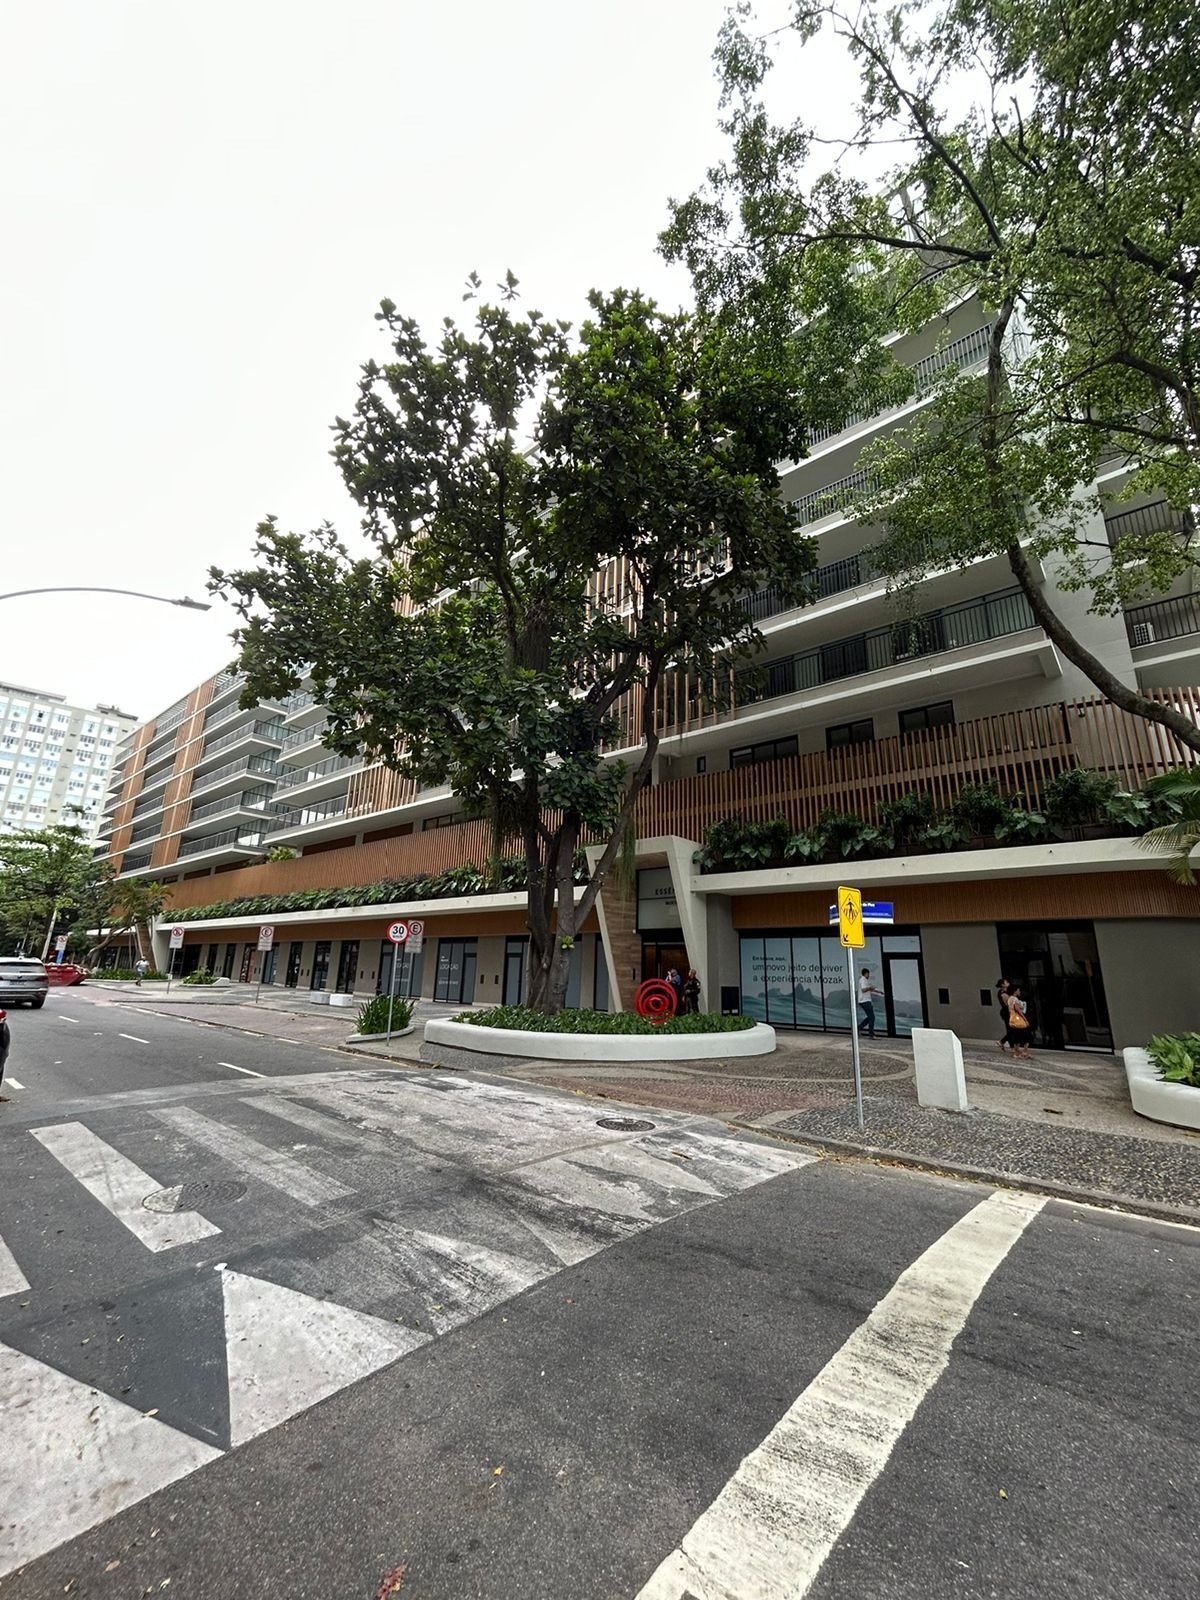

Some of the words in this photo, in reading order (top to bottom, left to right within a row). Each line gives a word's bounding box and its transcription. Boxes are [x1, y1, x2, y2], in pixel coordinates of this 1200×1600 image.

[392, 926, 404, 935] 30
[413, 925, 418, 933] E
[822, 964, 843, 972] viver
[814, 975, 844, 984] Mozak
